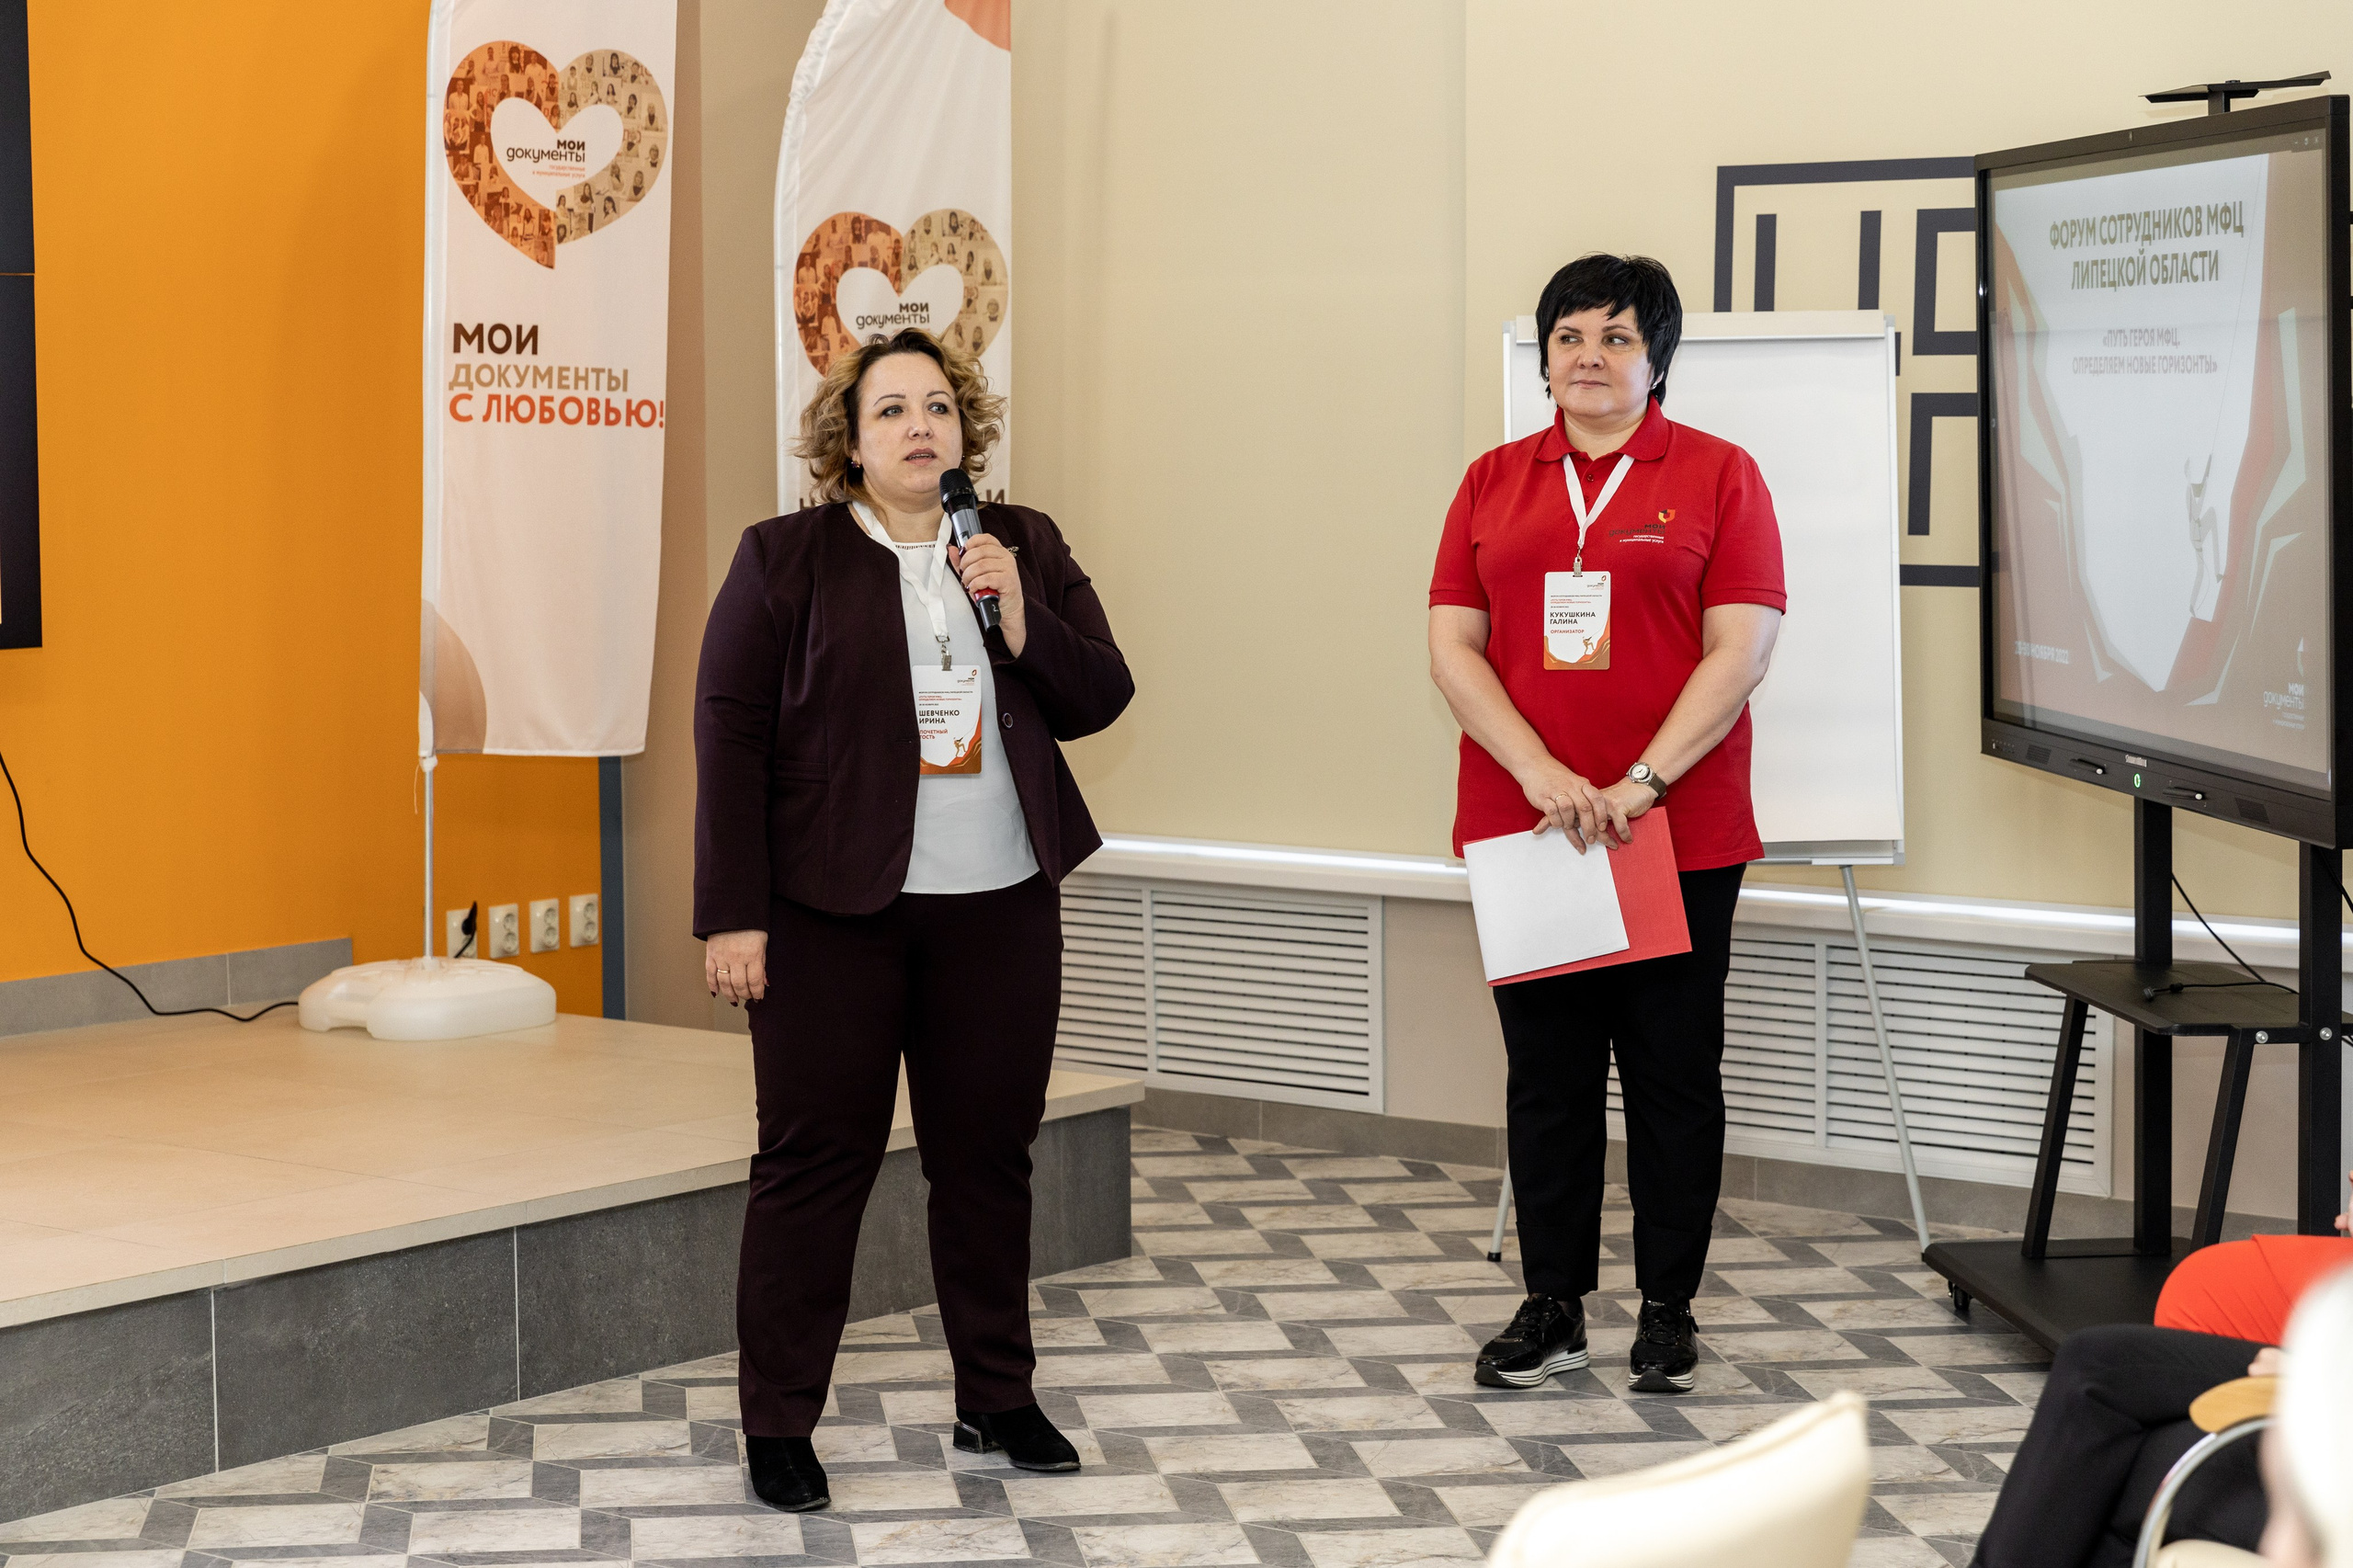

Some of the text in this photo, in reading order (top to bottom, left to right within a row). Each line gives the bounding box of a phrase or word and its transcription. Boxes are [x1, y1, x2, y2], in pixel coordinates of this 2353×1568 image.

[506, 147, 585, 164] документы
[2050, 200, 2244, 250] ФОРУМ СОТРУДНИКОВ МФЦ
[2072, 248, 2219, 291] ЛИПЕЦКОЙ ОБЛАСТИ
[856, 313, 930, 330] документы
[453, 323, 539, 355] МОИ
[2130, 328, 2154, 347] ГЕРОЯ
[449, 363, 629, 392] ДОКУМЕНТЫ
[2072, 354, 2218, 376] ОПРЕДЕЛЯЕМ НОВЫЕ ГОРИЗОНТЫ»
[449, 393, 665, 428] С ЛЮБОВЬЮ!
[2264, 691, 2304, 710] документы
